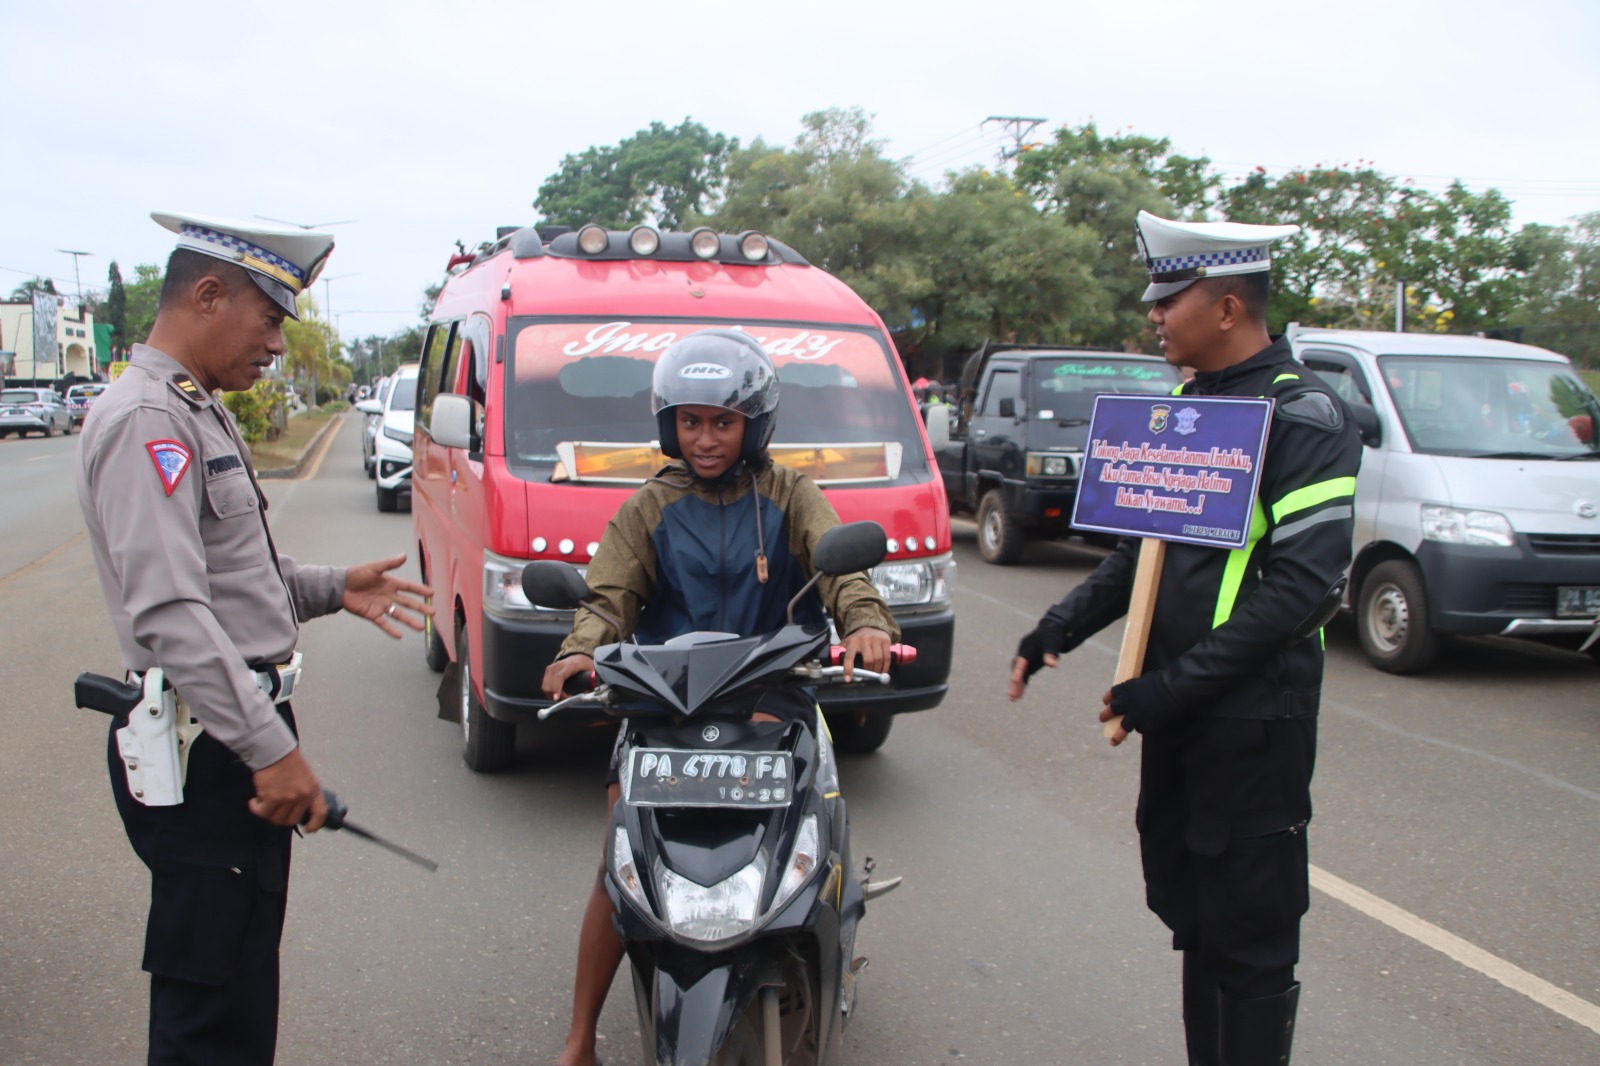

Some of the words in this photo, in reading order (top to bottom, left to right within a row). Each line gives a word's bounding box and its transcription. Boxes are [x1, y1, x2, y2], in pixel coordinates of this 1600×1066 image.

[684, 366, 726, 375] INK
[1092, 439, 1121, 464] Tolong
[1120, 441, 1141, 465] Jaga
[1140, 442, 1210, 467] Keselamatanmu
[1099, 462, 1120, 483] Aku
[1118, 464, 1143, 485] Cuma
[1142, 466, 1162, 487] Bisa
[1160, 467, 1198, 493] Ngejaga
[1197, 470, 1232, 493] Hatimu
[1115, 487, 1145, 508] Bukan
[640, 753, 672, 778] PA
[755, 756, 787, 780] FA
